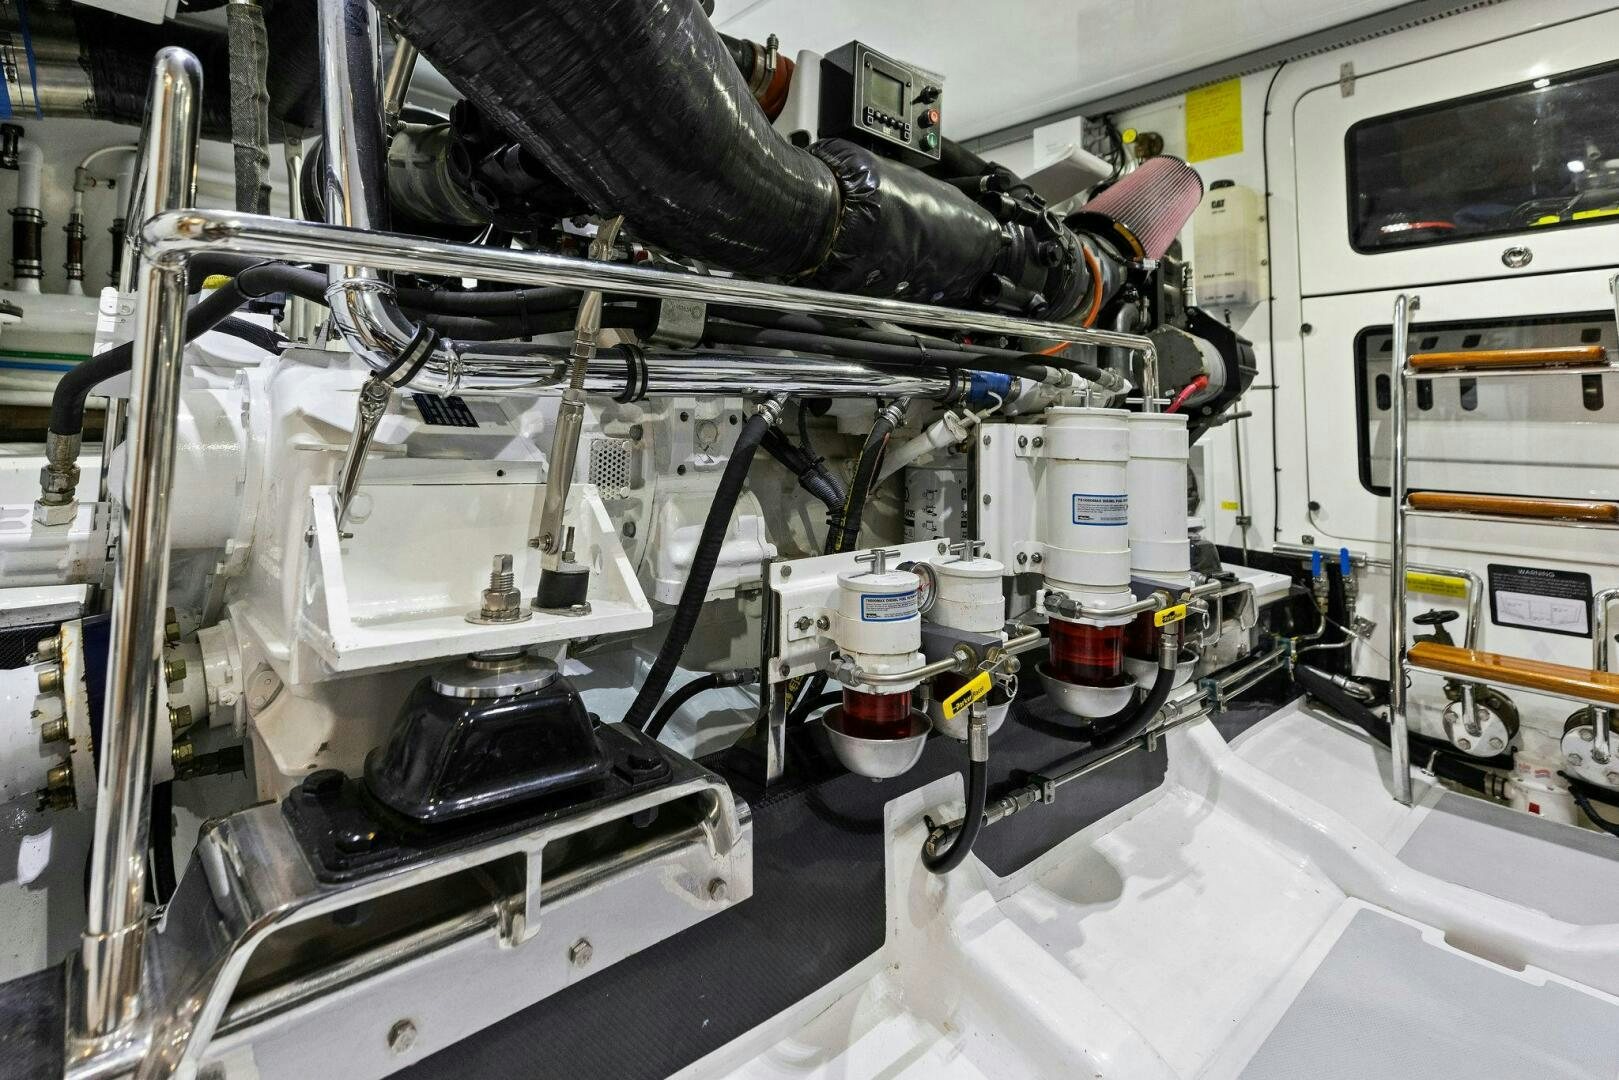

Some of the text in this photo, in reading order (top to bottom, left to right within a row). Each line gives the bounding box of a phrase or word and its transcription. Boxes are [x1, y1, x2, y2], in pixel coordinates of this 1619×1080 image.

[1211, 199, 1225, 209] CAT
[1519, 569, 1555, 578] WARNING
[952, 695, 972, 711] Parker
